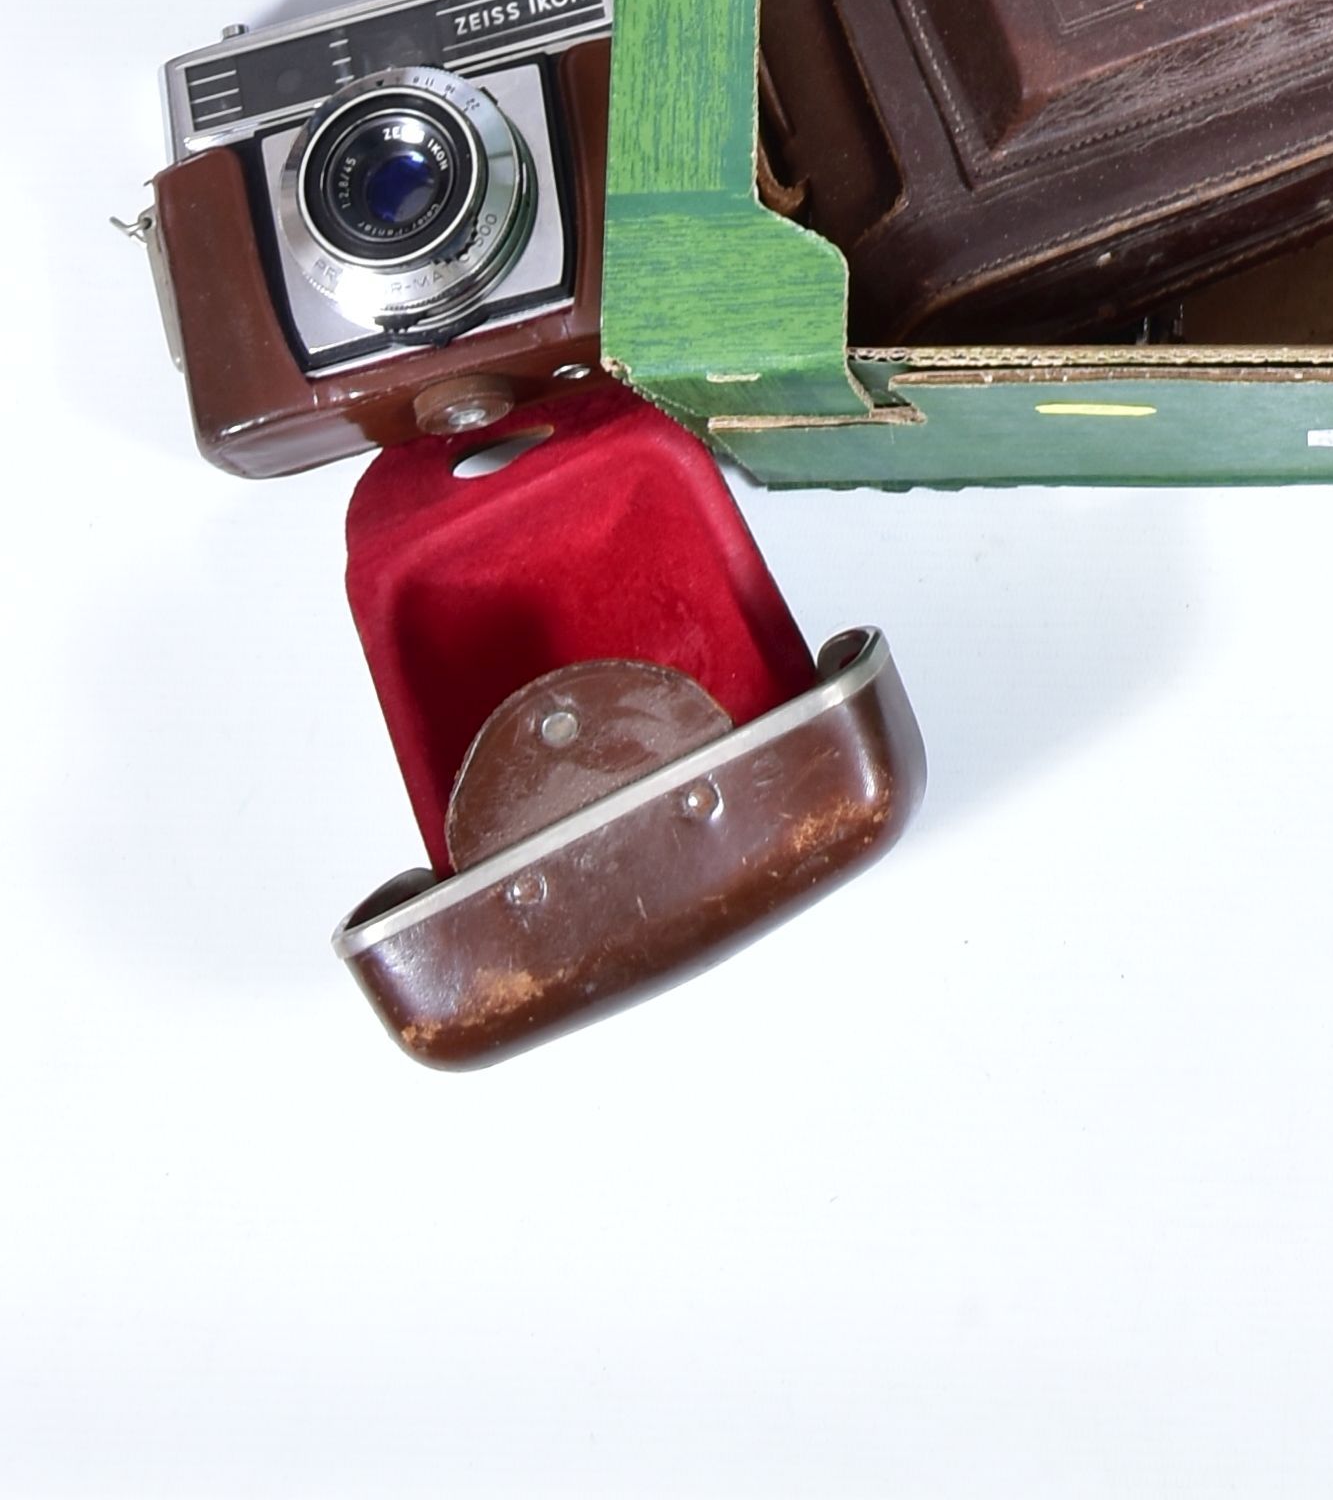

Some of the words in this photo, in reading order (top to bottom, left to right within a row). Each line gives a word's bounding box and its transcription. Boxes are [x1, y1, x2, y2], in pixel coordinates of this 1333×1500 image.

[454, 2, 520, 35] ZEISS
[427, 139, 449, 171] IKON
[476, 213, 497, 247] 500
